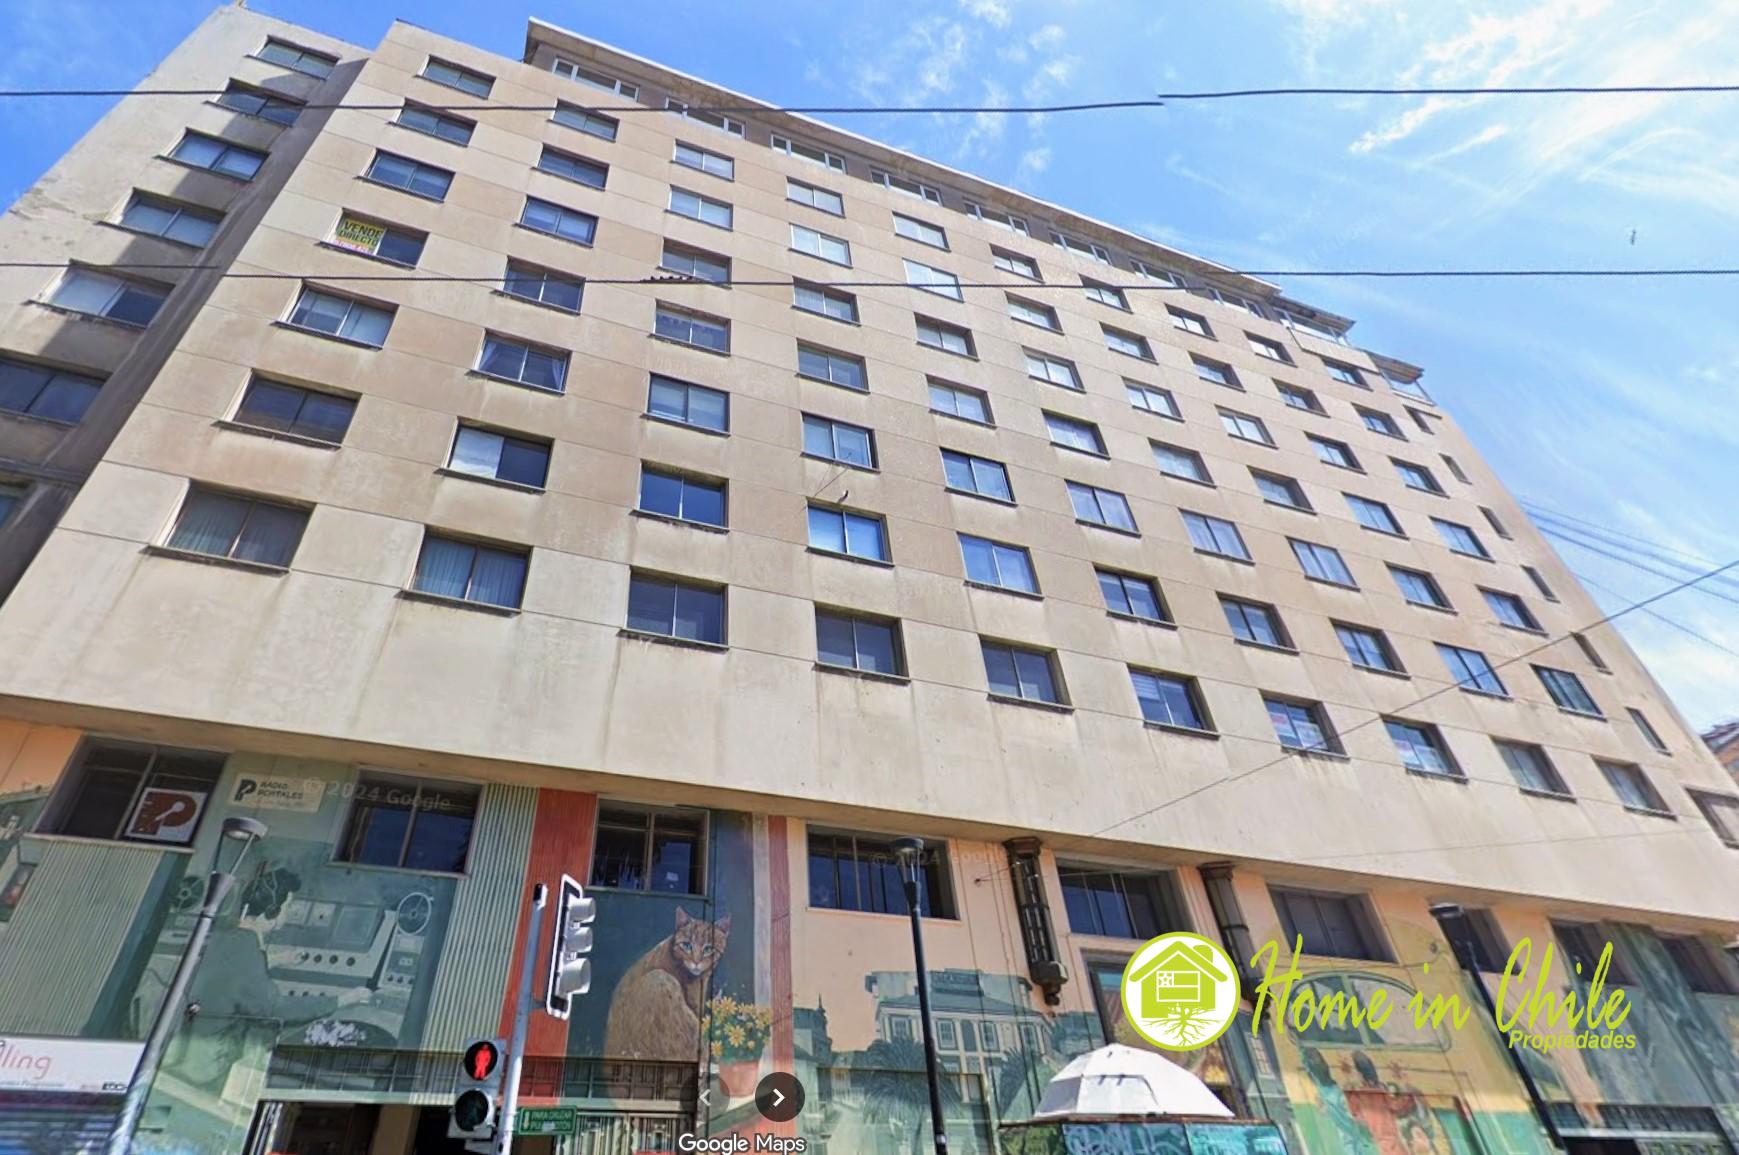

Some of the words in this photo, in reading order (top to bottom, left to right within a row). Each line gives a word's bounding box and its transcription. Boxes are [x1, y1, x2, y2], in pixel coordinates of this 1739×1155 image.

[344, 220, 384, 237] VENDE
[339, 230, 380, 247] DIRECTO
[258, 781, 288, 790] RADIO
[257, 789, 304, 800] PORTALES
